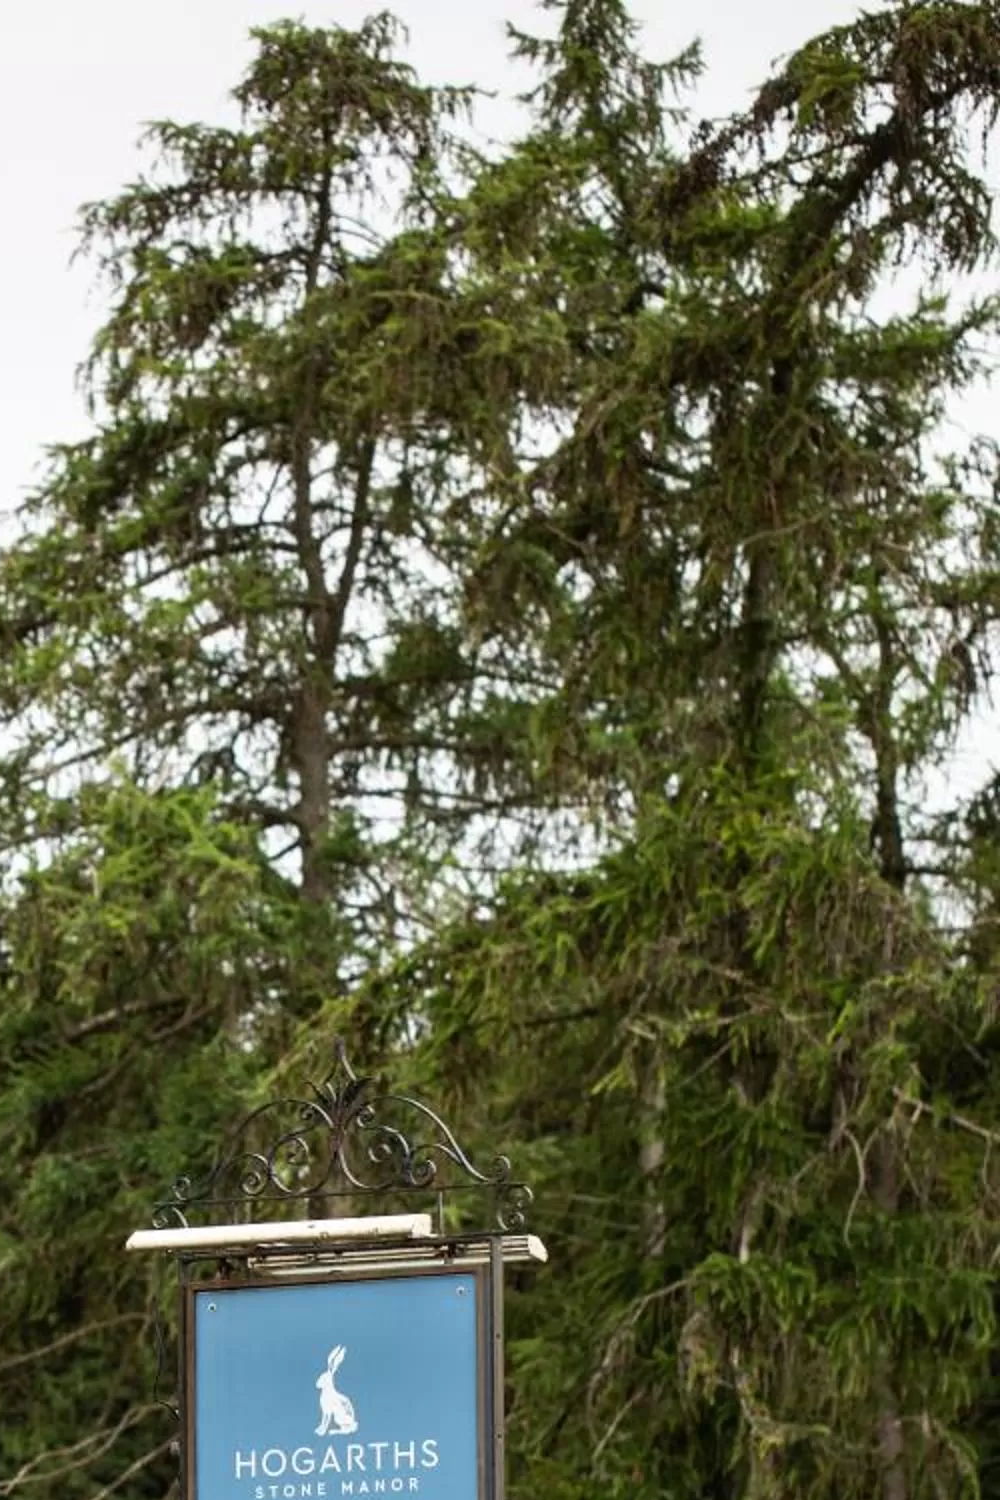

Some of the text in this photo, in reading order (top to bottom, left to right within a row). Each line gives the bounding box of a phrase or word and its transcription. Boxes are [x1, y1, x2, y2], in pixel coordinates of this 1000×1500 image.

[234, 1439, 440, 1479] HOGARTHS
[255, 1477, 420, 1500] STONE MANOR
